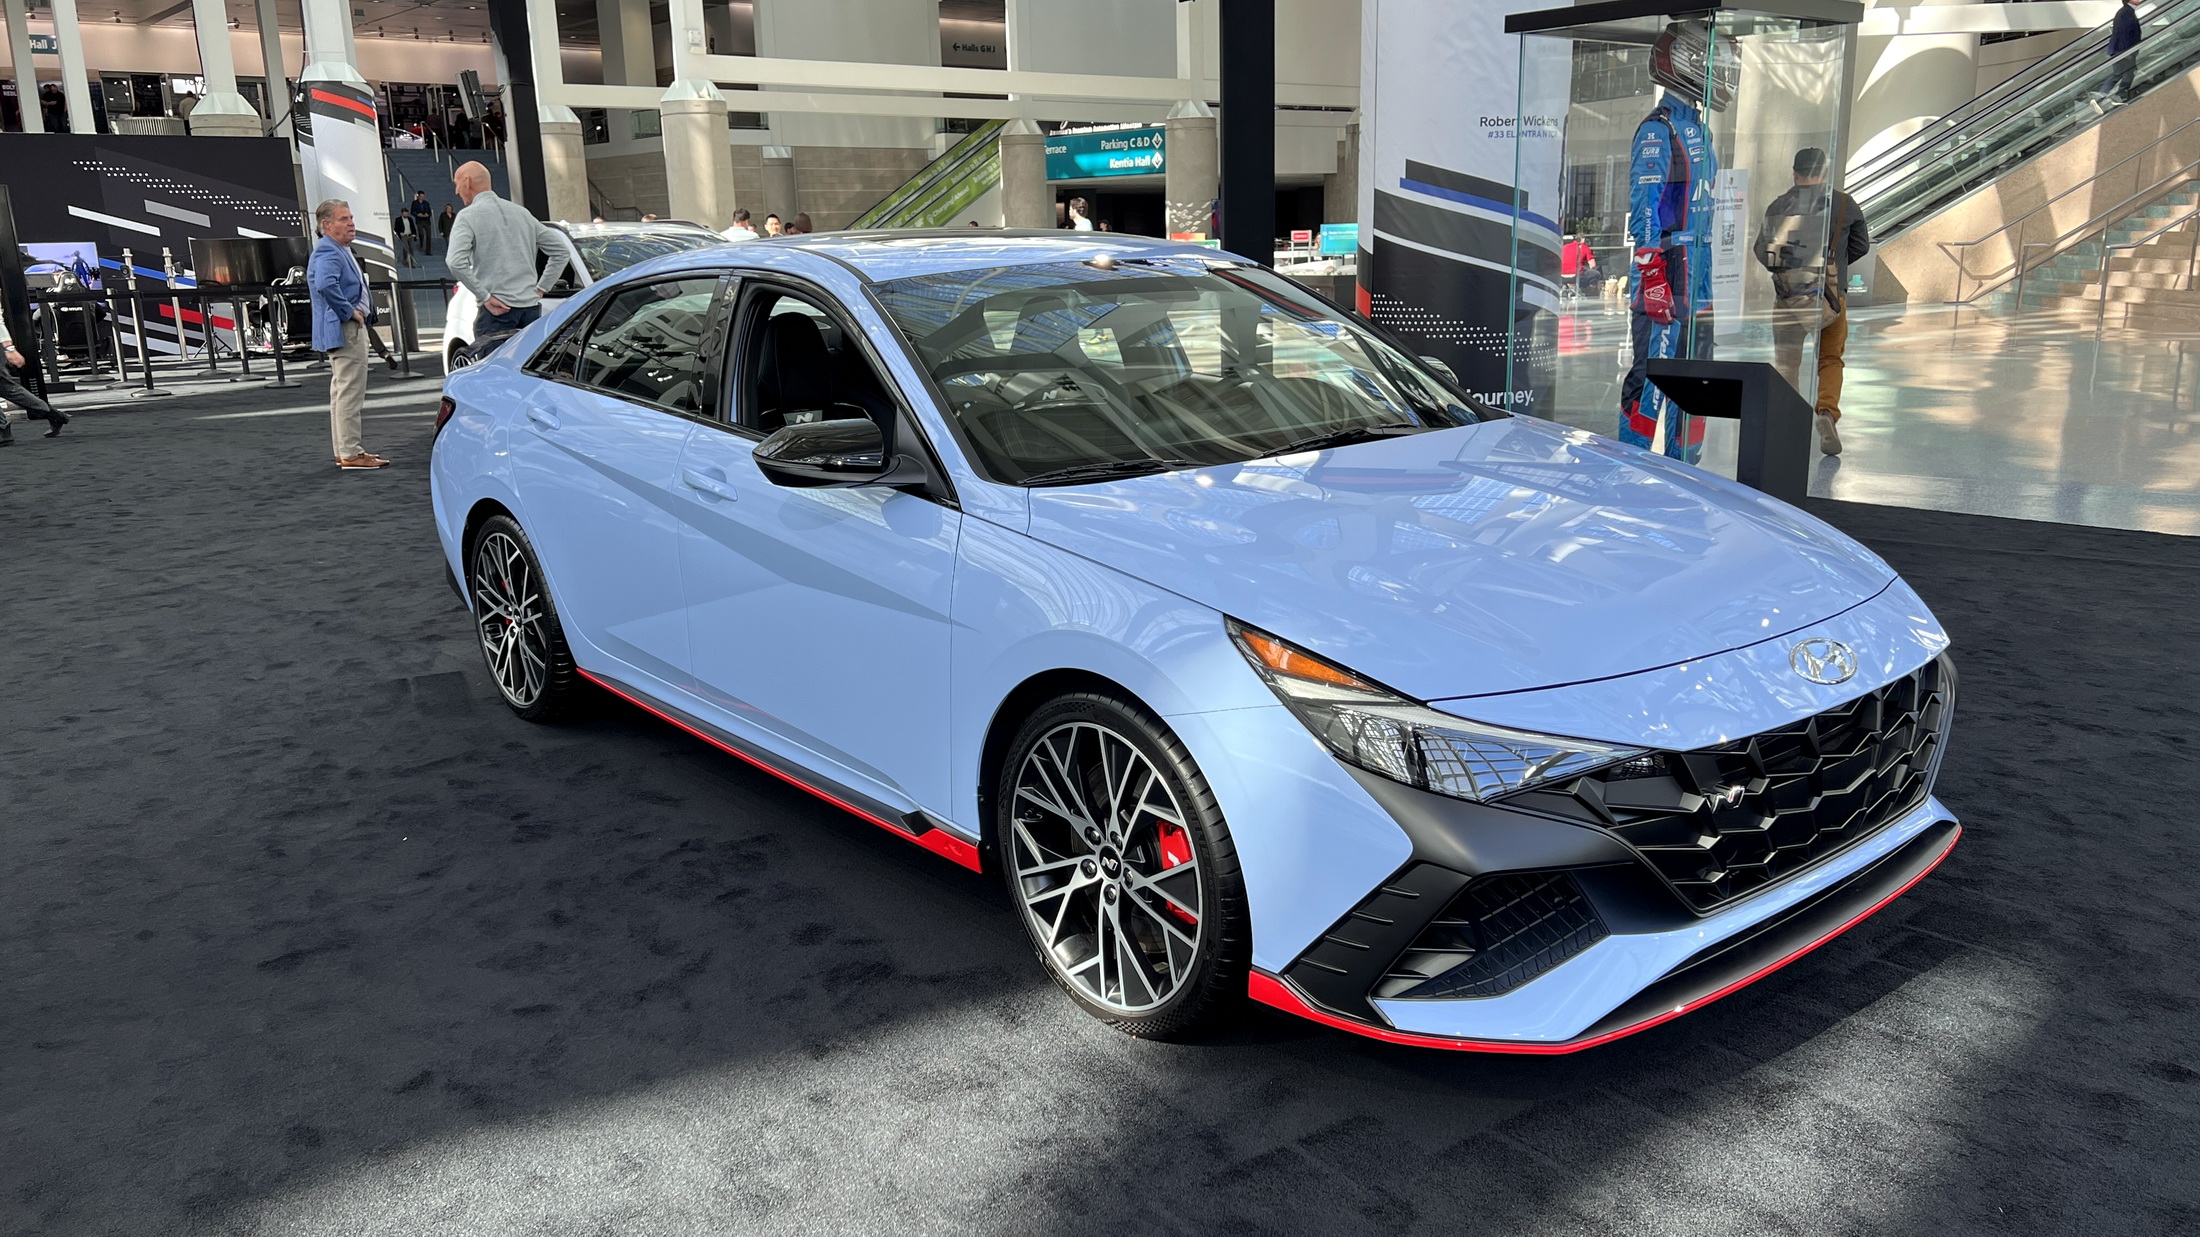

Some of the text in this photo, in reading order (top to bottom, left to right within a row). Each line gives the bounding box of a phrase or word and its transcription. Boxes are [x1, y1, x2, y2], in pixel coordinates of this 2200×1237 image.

[30, 39, 58, 50] Hall J
[962, 44, 978, 52] Halls
[987, 45, 991, 53] H
[1523, 115, 1559, 126] Wickens
[1487, 130, 1505, 138] #33
[1506, 130, 1541, 138] ELNTRA
[1101, 137, 1150, 151] Parking C & D
[1109, 155, 1151, 168] Kentia Hall
[1467, 388, 1535, 407] ourney.
